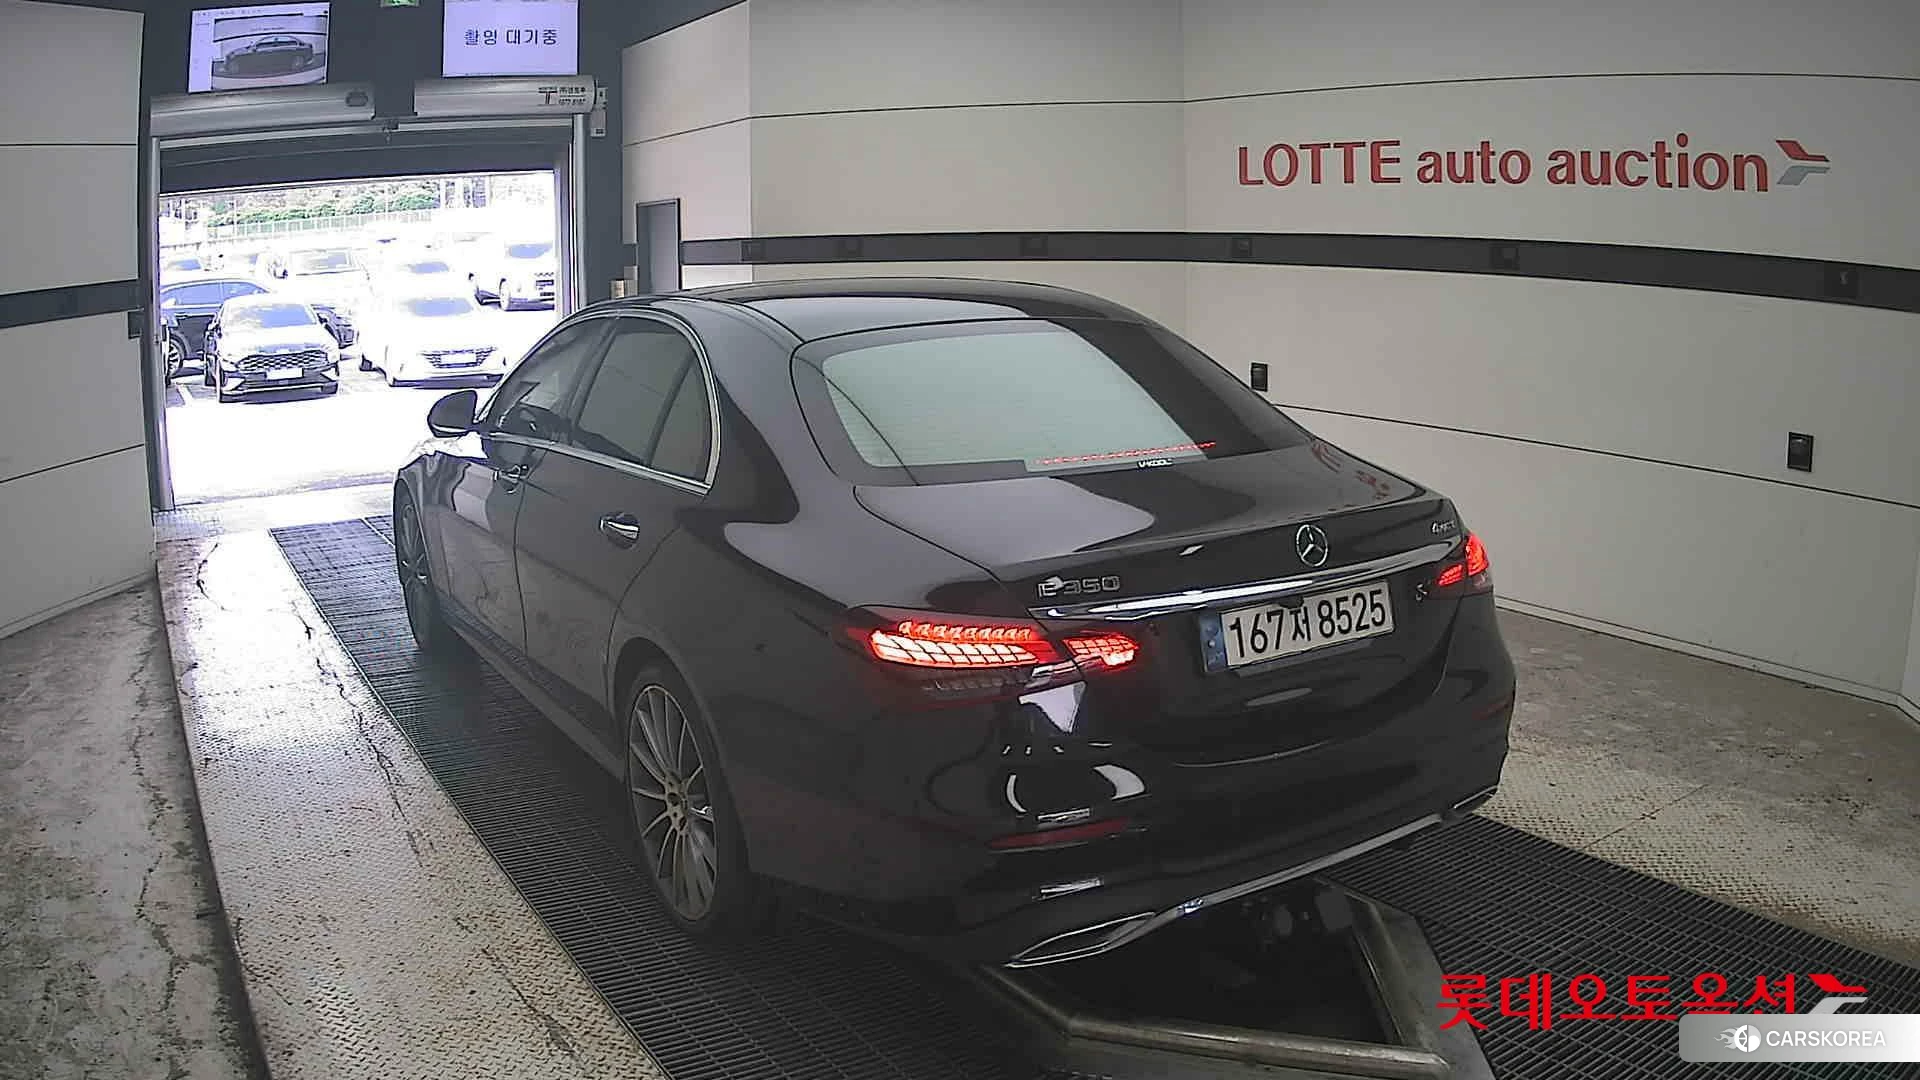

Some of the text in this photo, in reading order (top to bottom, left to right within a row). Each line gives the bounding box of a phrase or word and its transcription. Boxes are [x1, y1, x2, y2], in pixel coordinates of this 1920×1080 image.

[505, 28, 558, 46] 대기중
[1238, 133, 1769, 192] LOTTE auto auction
[1317, 589, 1386, 638] 8525
